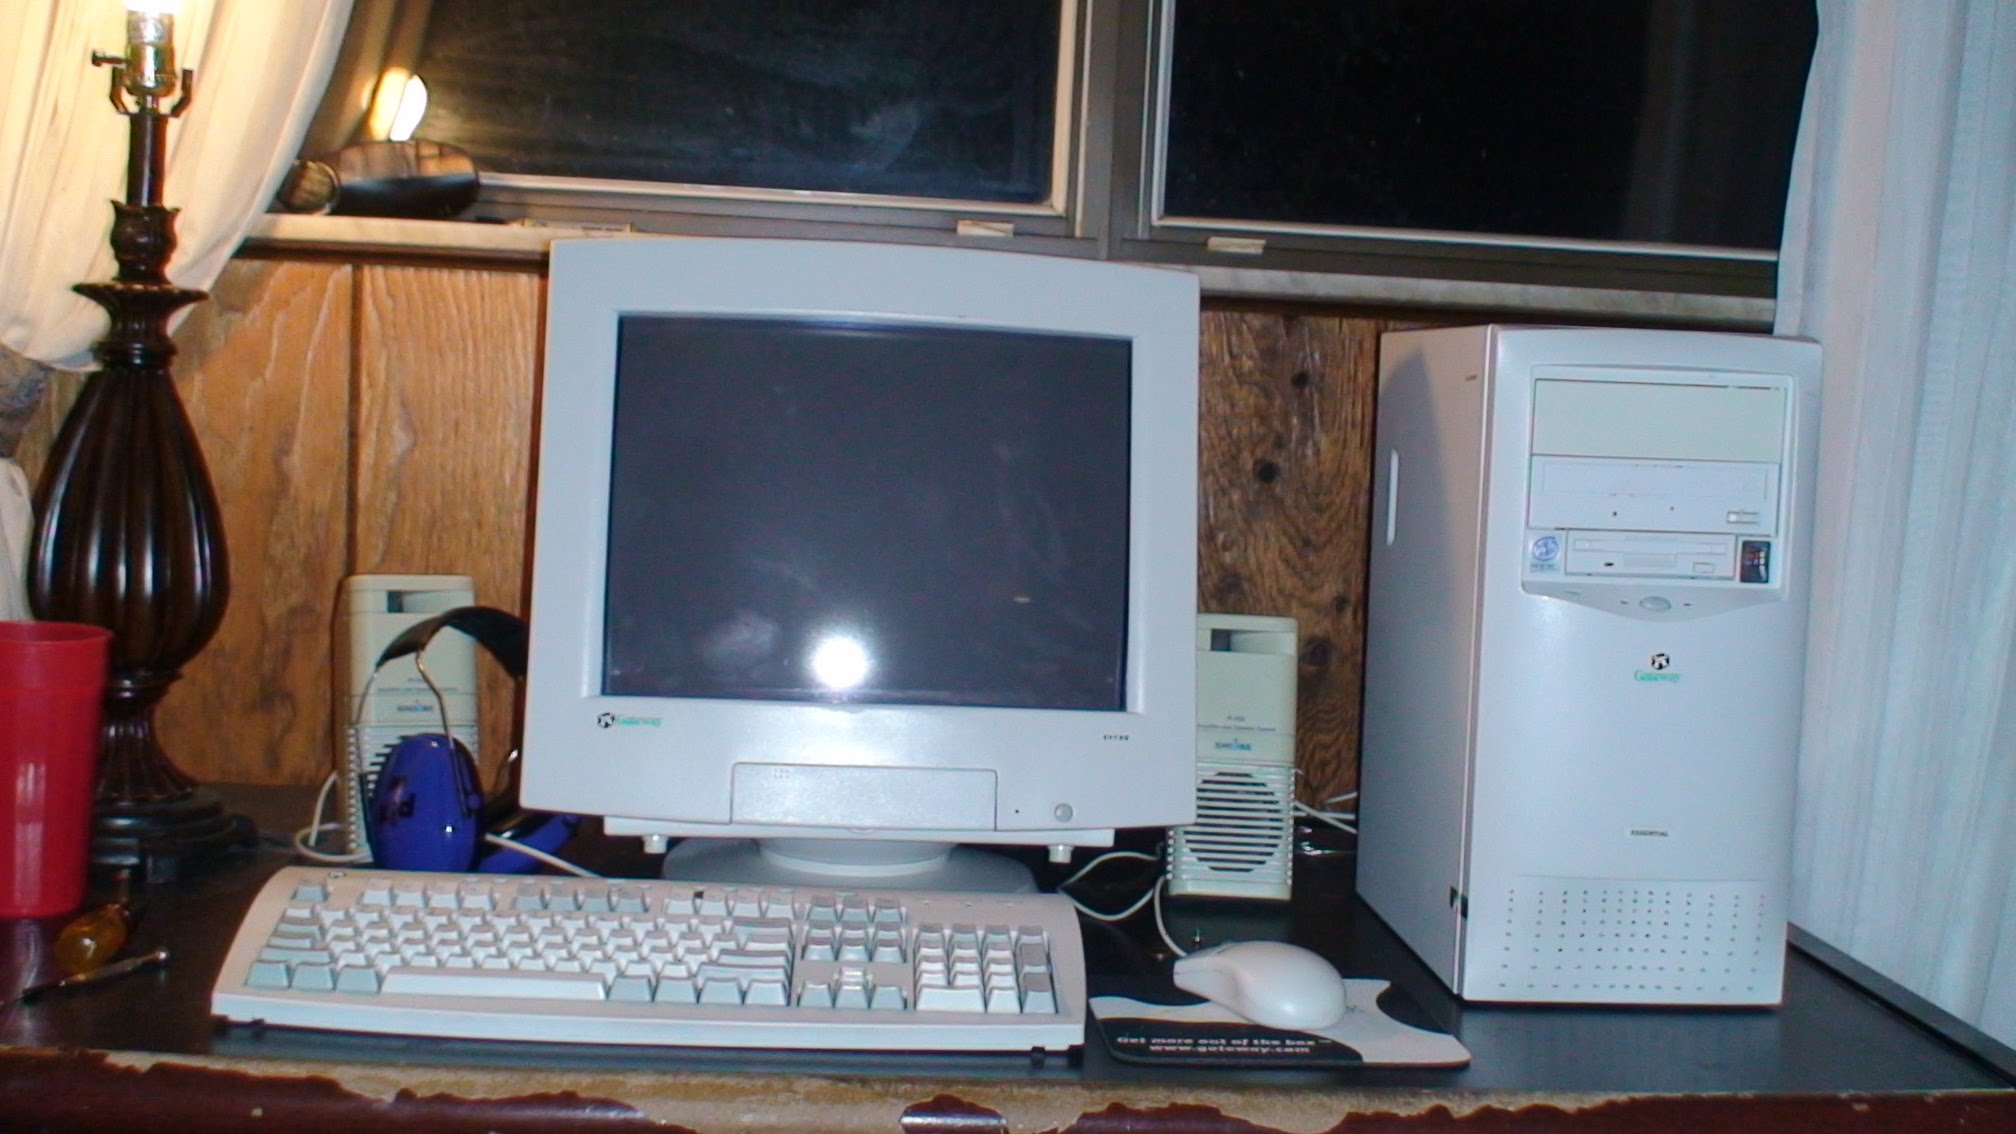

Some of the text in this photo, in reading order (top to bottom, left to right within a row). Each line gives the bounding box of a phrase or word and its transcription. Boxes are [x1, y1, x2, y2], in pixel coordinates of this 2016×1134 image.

[1633, 669, 1680, 684] Gateway
[1116, 1036, 1146, 1045] Get
[1150, 1037, 1194, 1046] more
[1197, 1038, 1227, 1047] out
[1231, 1038, 1249, 1047] of
[1149, 1045, 1311, 1055] www.gateway.com
